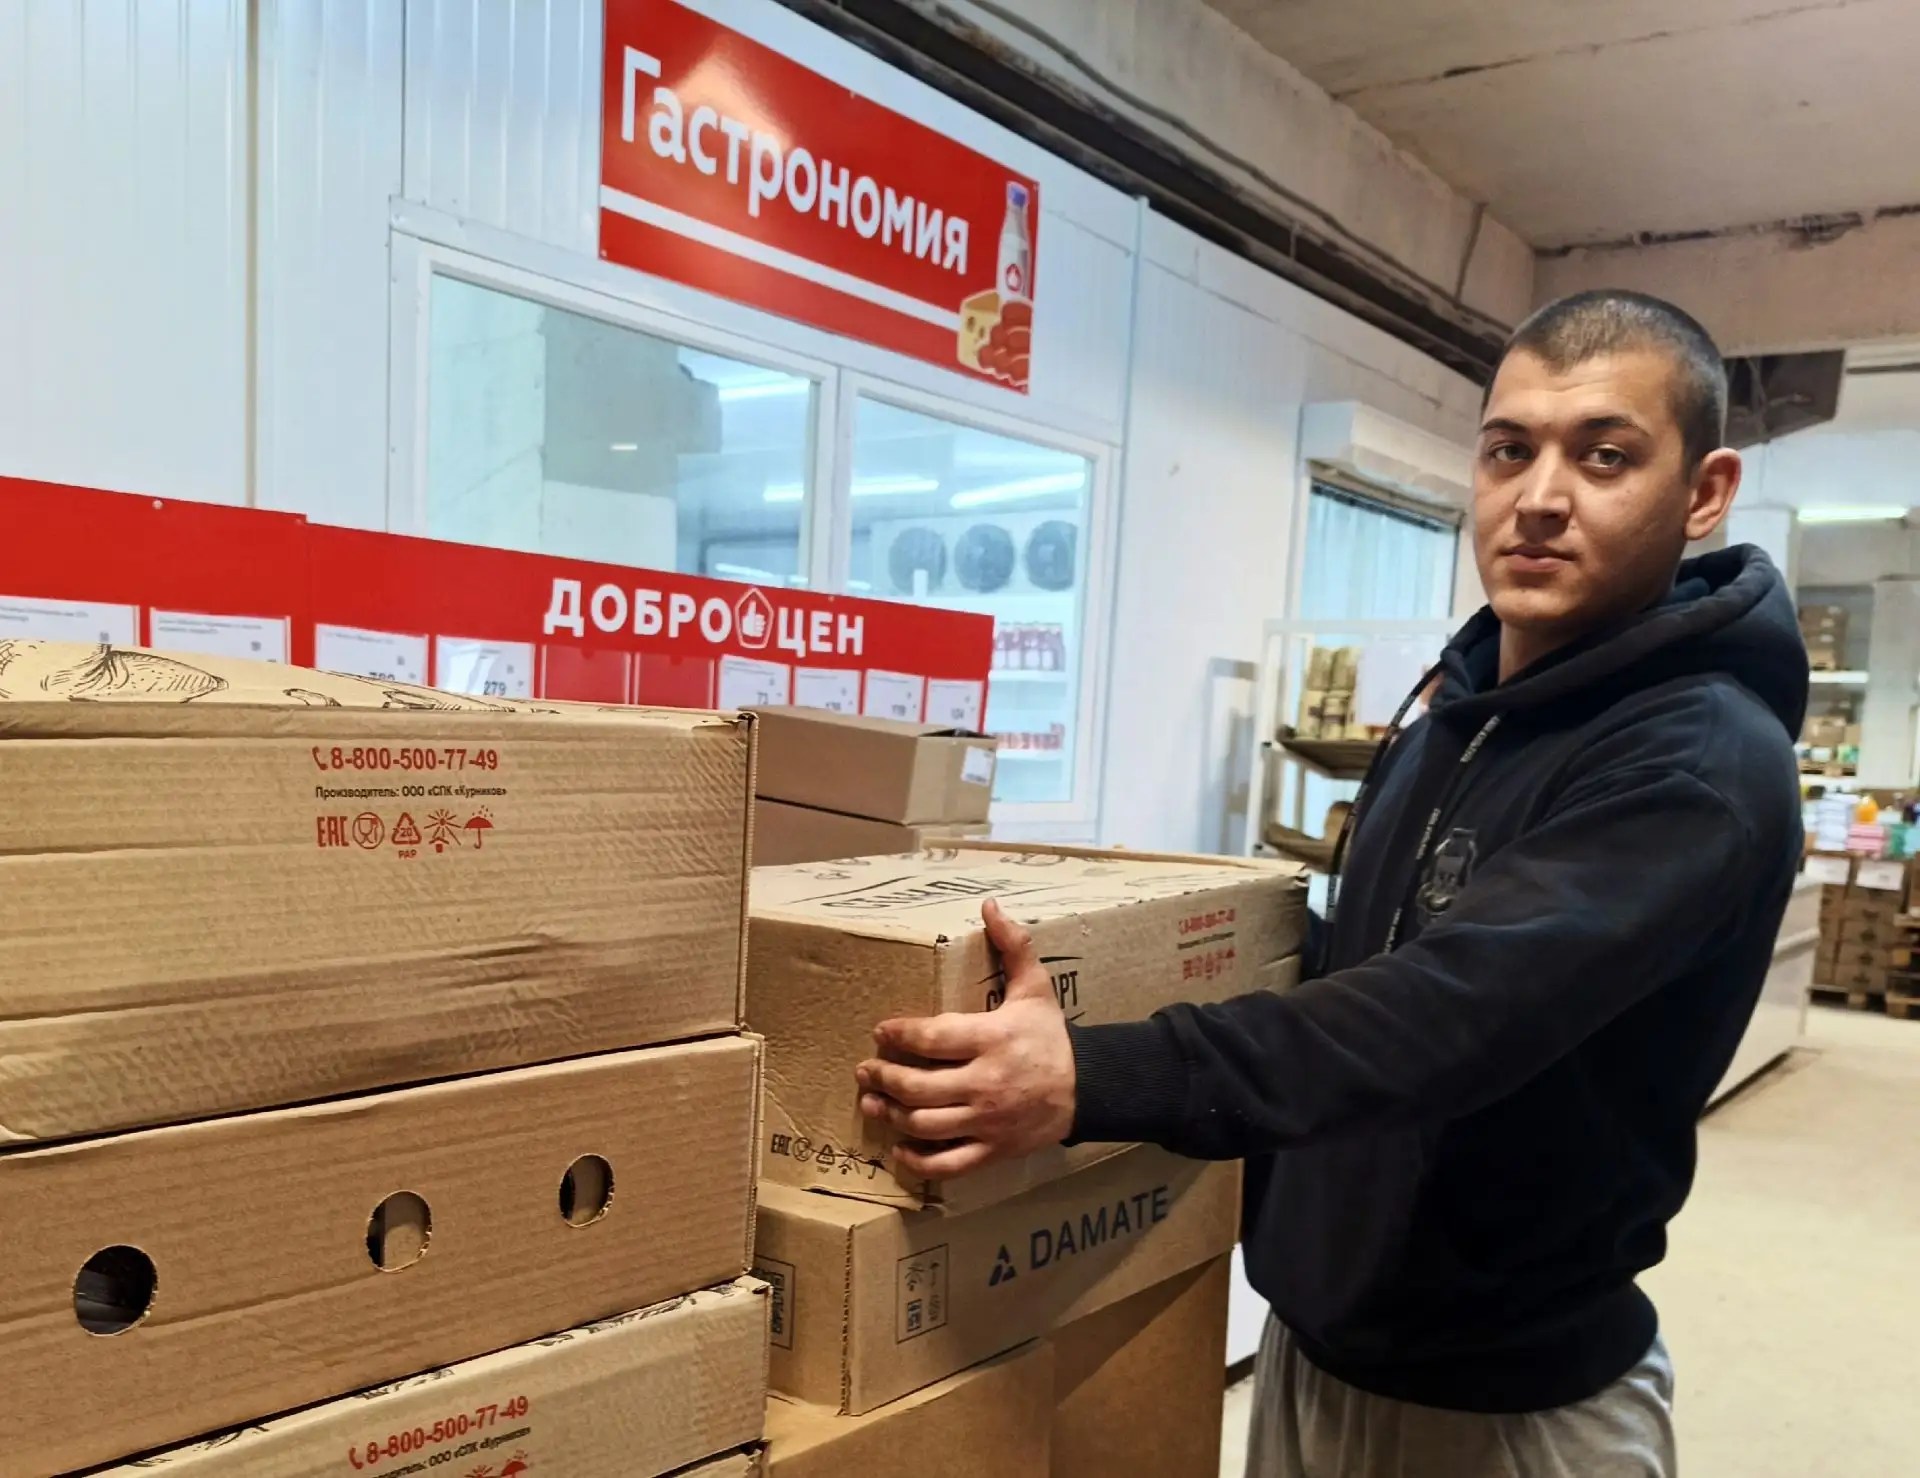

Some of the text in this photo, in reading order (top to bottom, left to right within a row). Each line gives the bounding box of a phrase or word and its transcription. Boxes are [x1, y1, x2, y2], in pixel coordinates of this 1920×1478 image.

[621, 45, 969, 275] Гастрономия
[484, 680, 506, 696] 279
[330, 747, 498, 770] 8-800-500-77-49
[315, 786, 399, 800] Производитель:
[402, 785, 424, 797] ООО
[1029, 1184, 1170, 1270] DAMATE
[366, 1395, 529, 1465] 8-800-500-77-49
